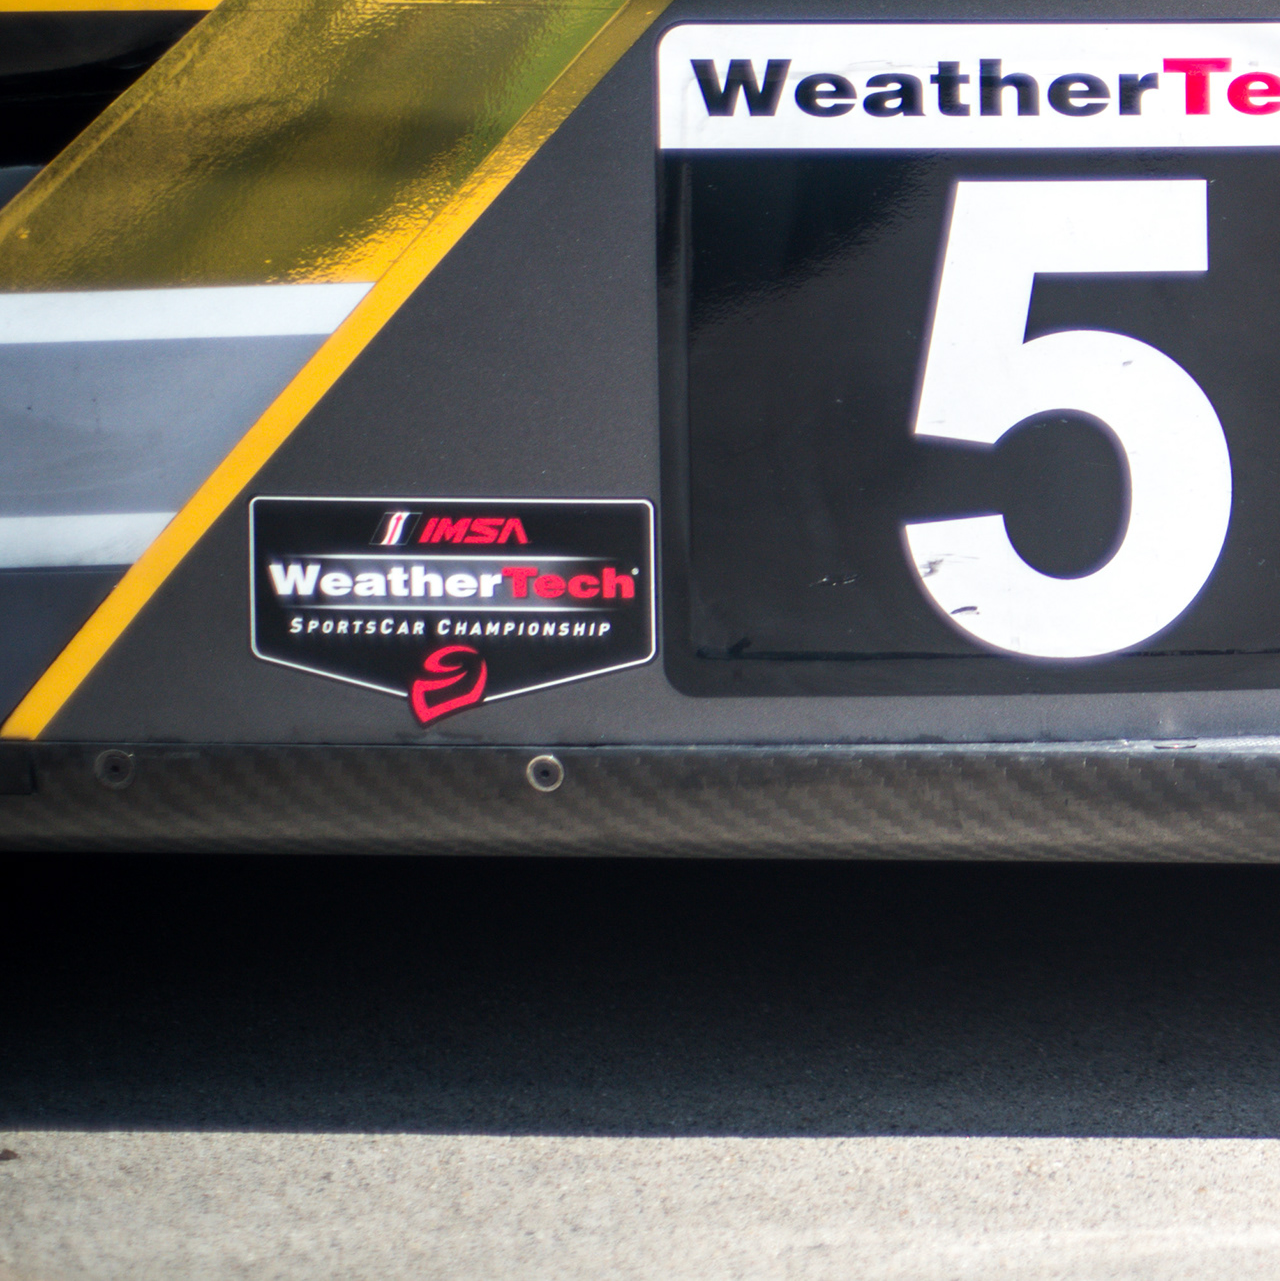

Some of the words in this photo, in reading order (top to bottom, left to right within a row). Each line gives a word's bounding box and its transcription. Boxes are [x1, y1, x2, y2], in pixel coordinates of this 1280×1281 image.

[905, 178, 1234, 660] 5
[417, 516, 531, 545] IMSA
[437, 618, 612, 638] CHAMPIONSHIP
